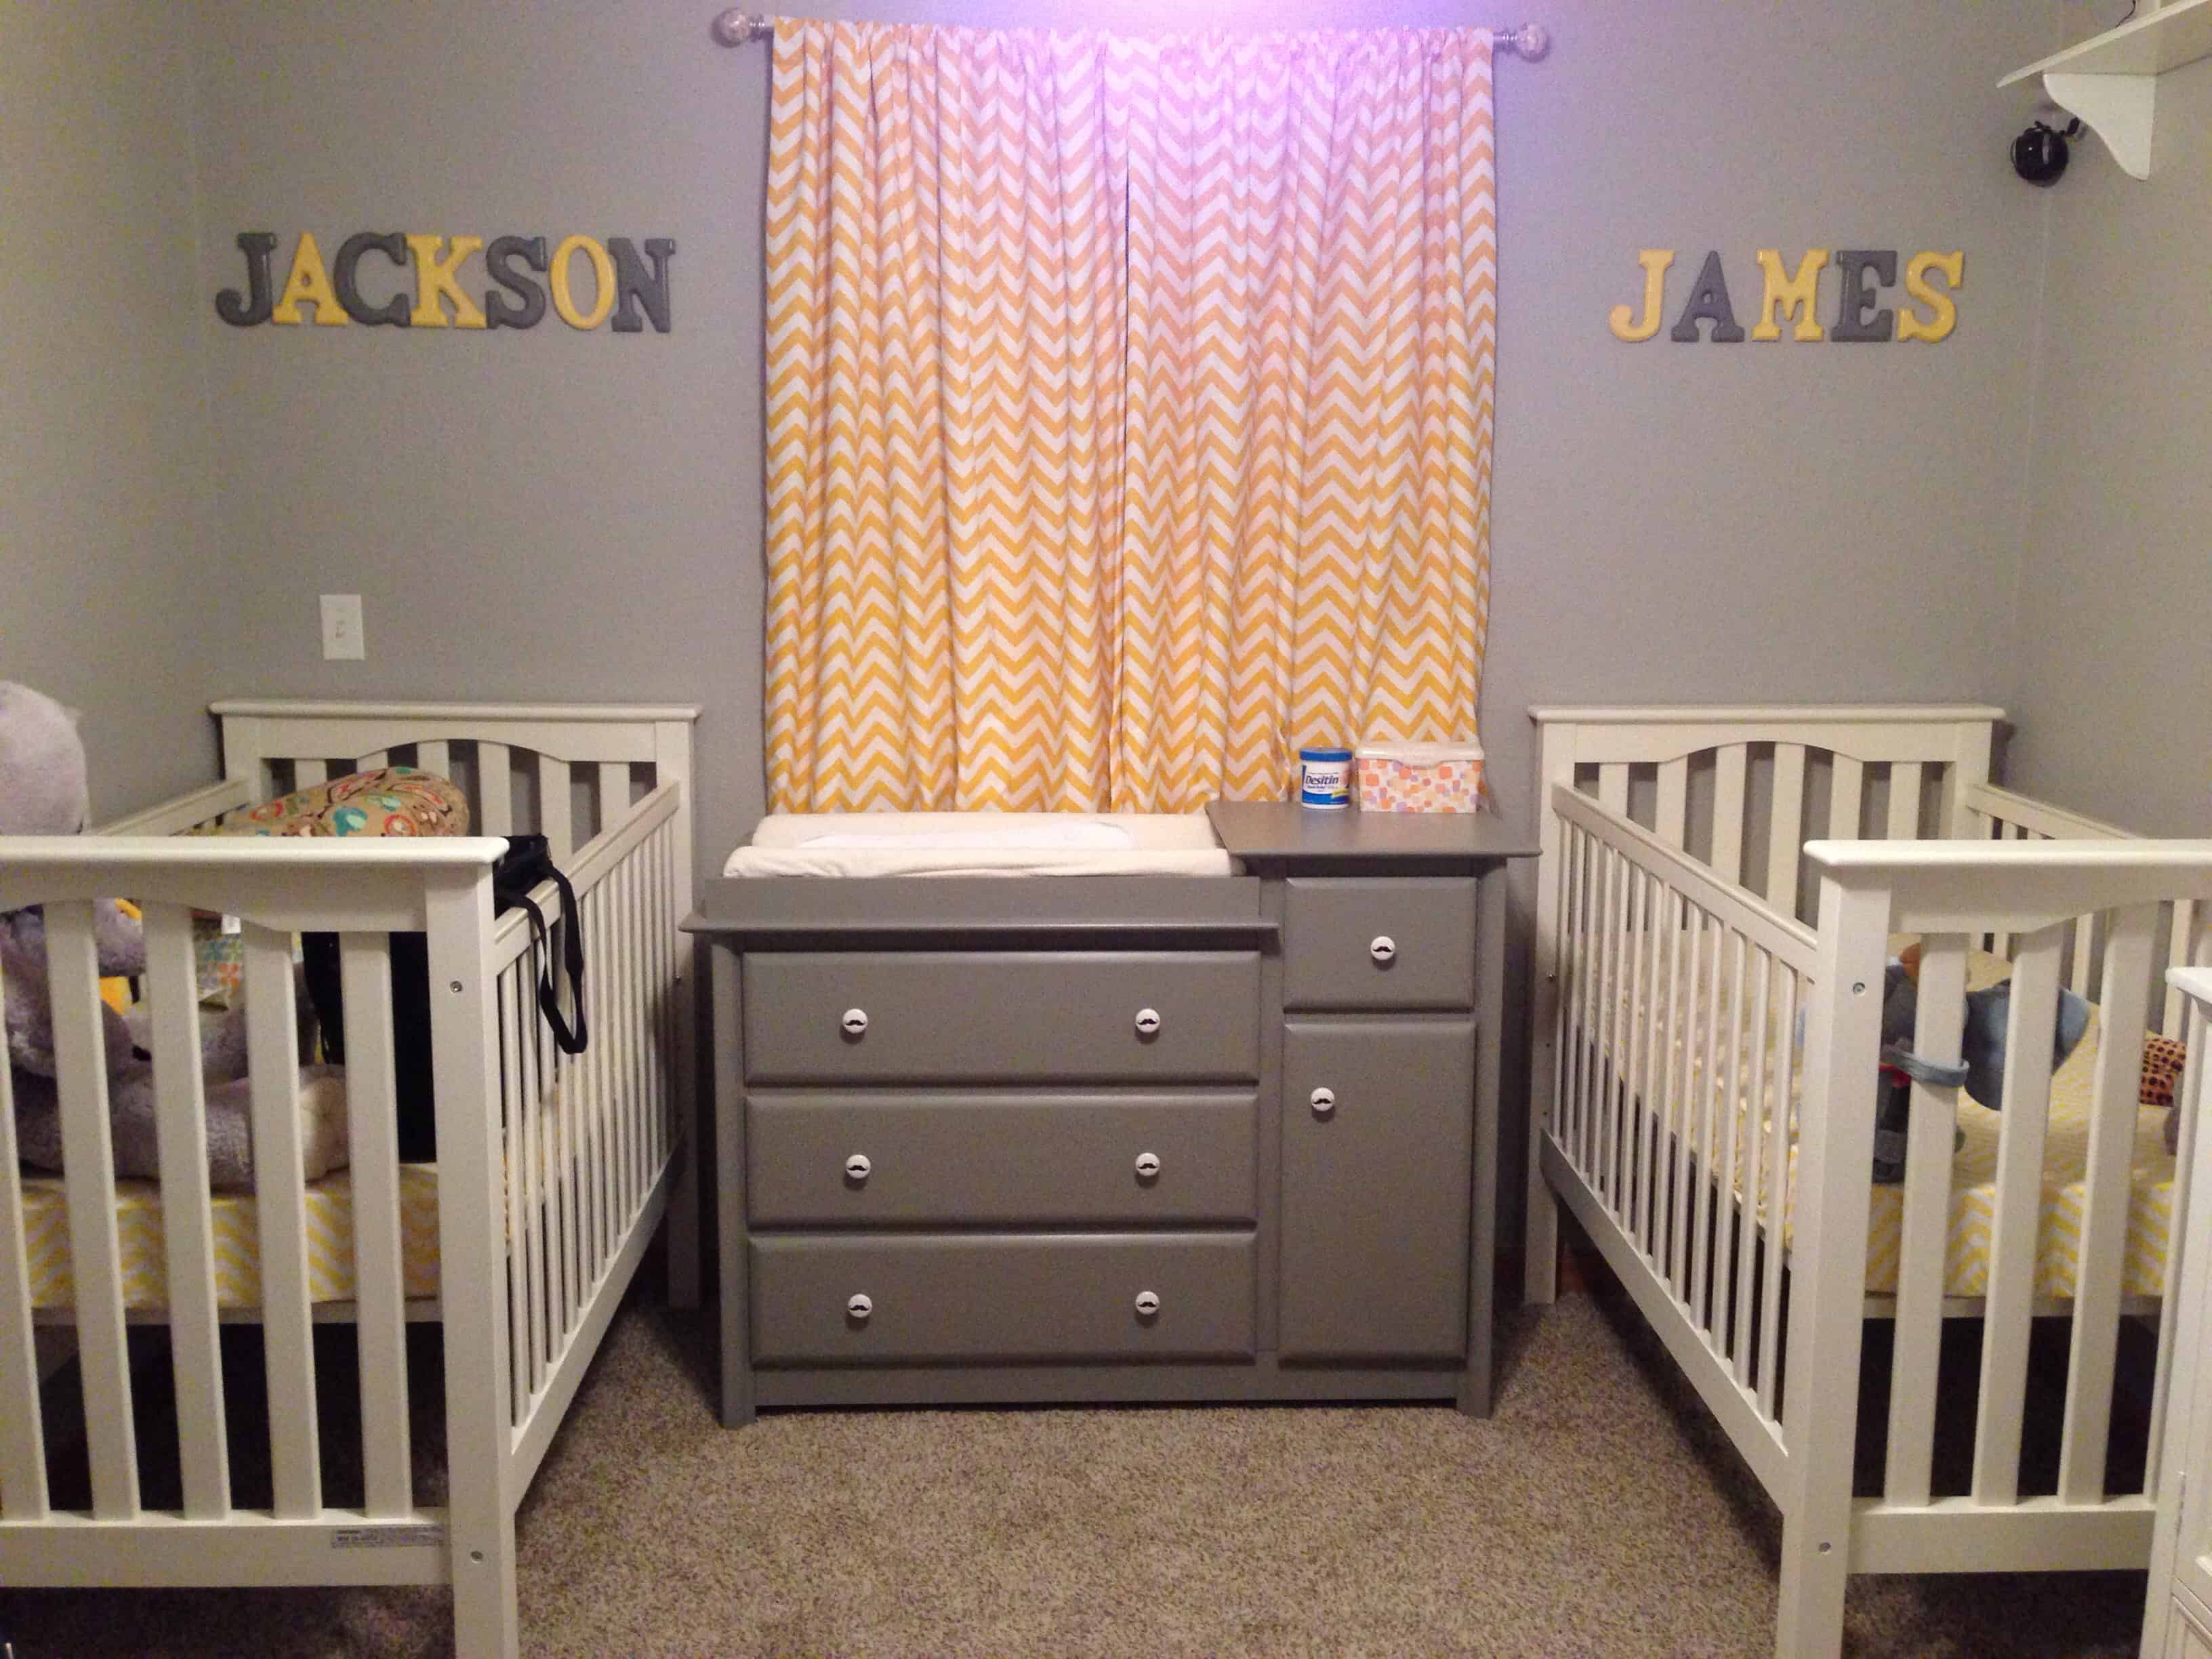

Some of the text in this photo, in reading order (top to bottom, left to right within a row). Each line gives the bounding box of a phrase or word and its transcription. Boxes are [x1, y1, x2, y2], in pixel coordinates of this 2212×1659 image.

[216, 231, 676, 333] JACKSON
[1608, 249, 1964, 344] JAMES
[1305, 775, 1339, 785] Desitin
